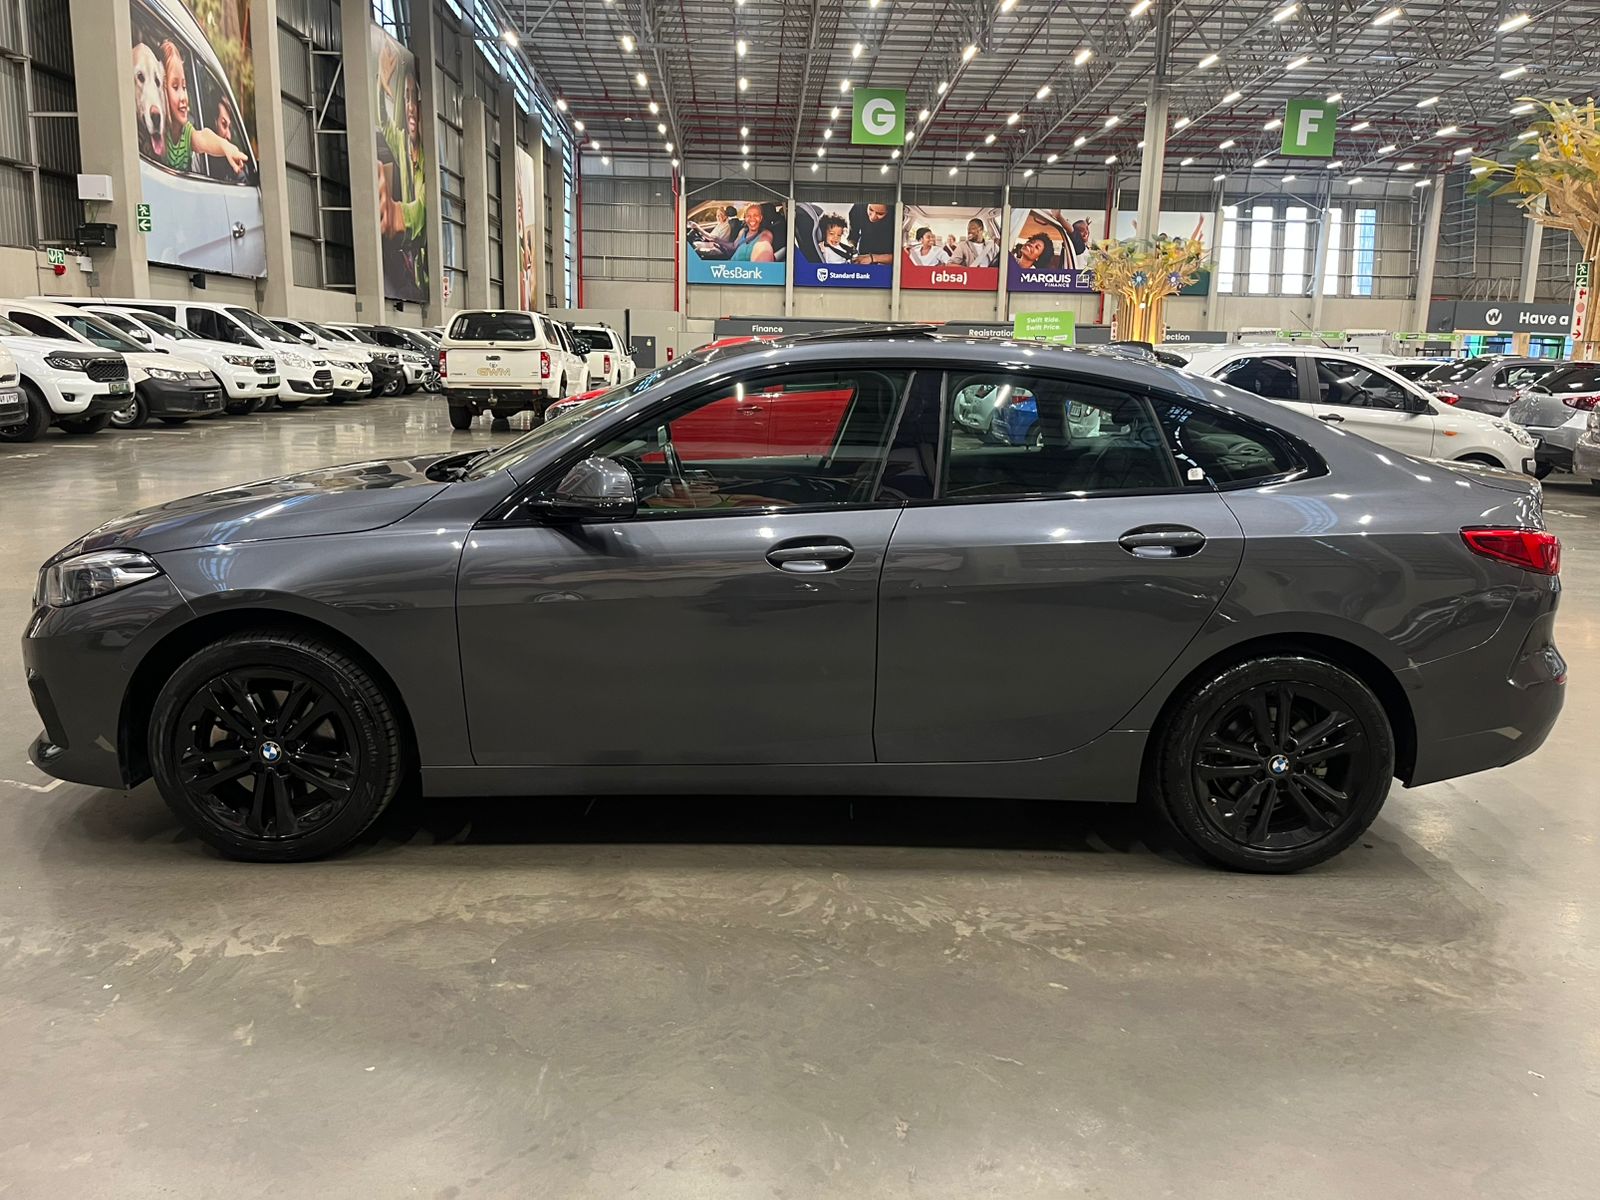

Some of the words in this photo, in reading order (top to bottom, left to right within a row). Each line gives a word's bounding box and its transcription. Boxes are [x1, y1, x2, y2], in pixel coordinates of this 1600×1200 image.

[862, 98, 896, 136] G
[1296, 109, 1324, 146] F
[710, 265, 762, 279] WesBank
[829, 272, 855, 280] Standard
[1020, 273, 1071, 283] MARQUIS
[1044, 316, 1061, 324] Ride.
[1519, 312, 1557, 325] Have
[1559, 315, 1569, 325] a
[752, 325, 784, 333] Finance
[1166, 333, 1190, 341] ection
